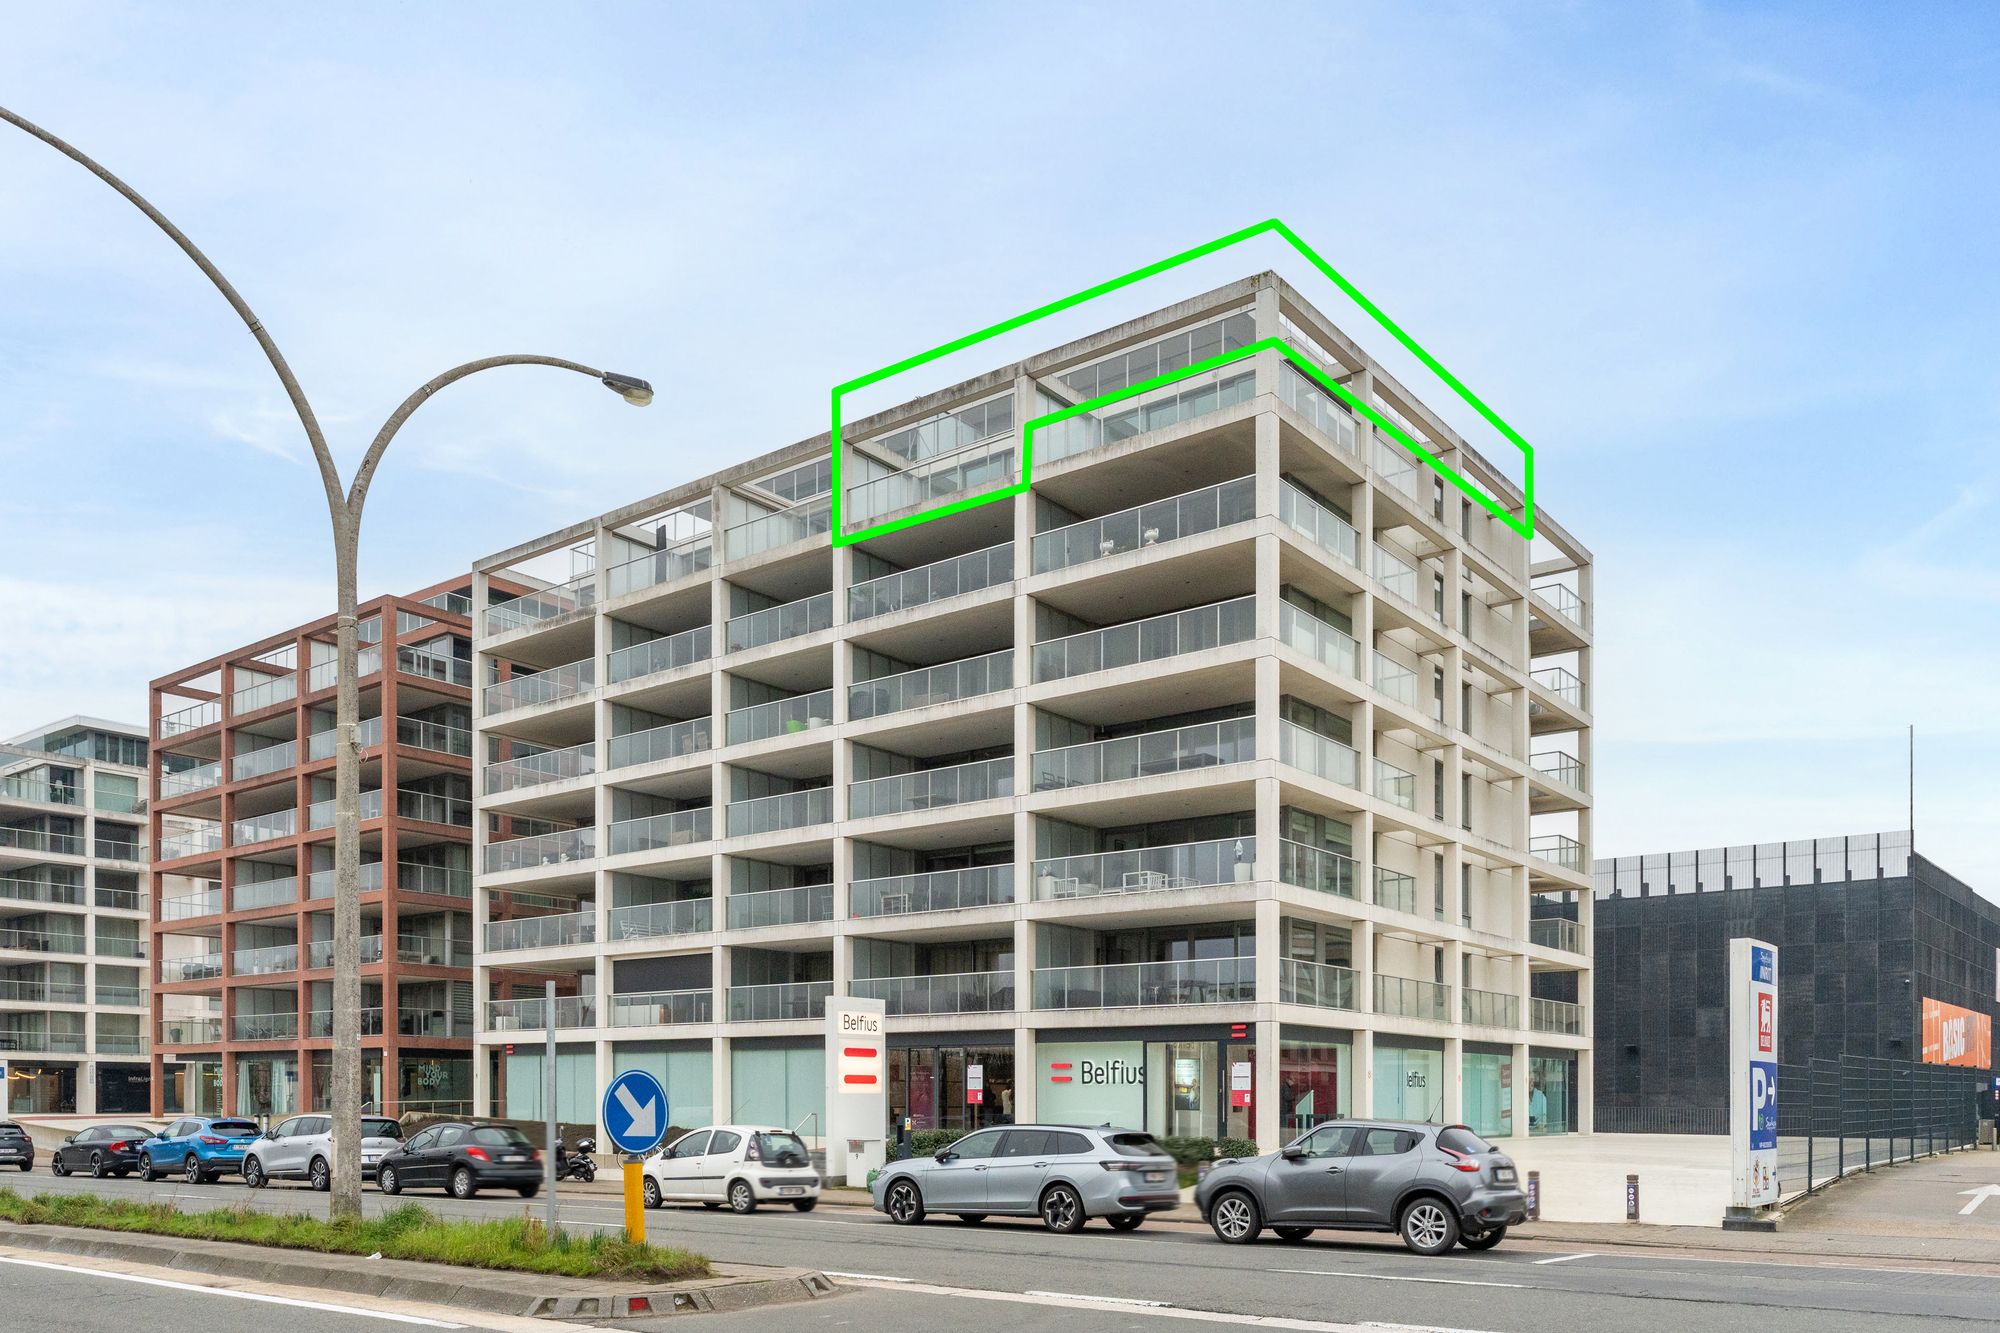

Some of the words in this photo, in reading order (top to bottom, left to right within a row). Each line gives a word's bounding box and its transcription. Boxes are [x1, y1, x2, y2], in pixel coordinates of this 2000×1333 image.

[843, 1014, 878, 1032] Belfius
[418, 1064, 441, 1072] MIND
[425, 1070, 449, 1080] YOUR
[1081, 1060, 1144, 1085] Belfius
[417, 1077, 441, 1086] BODY
[1752, 1067, 1767, 1131] P
